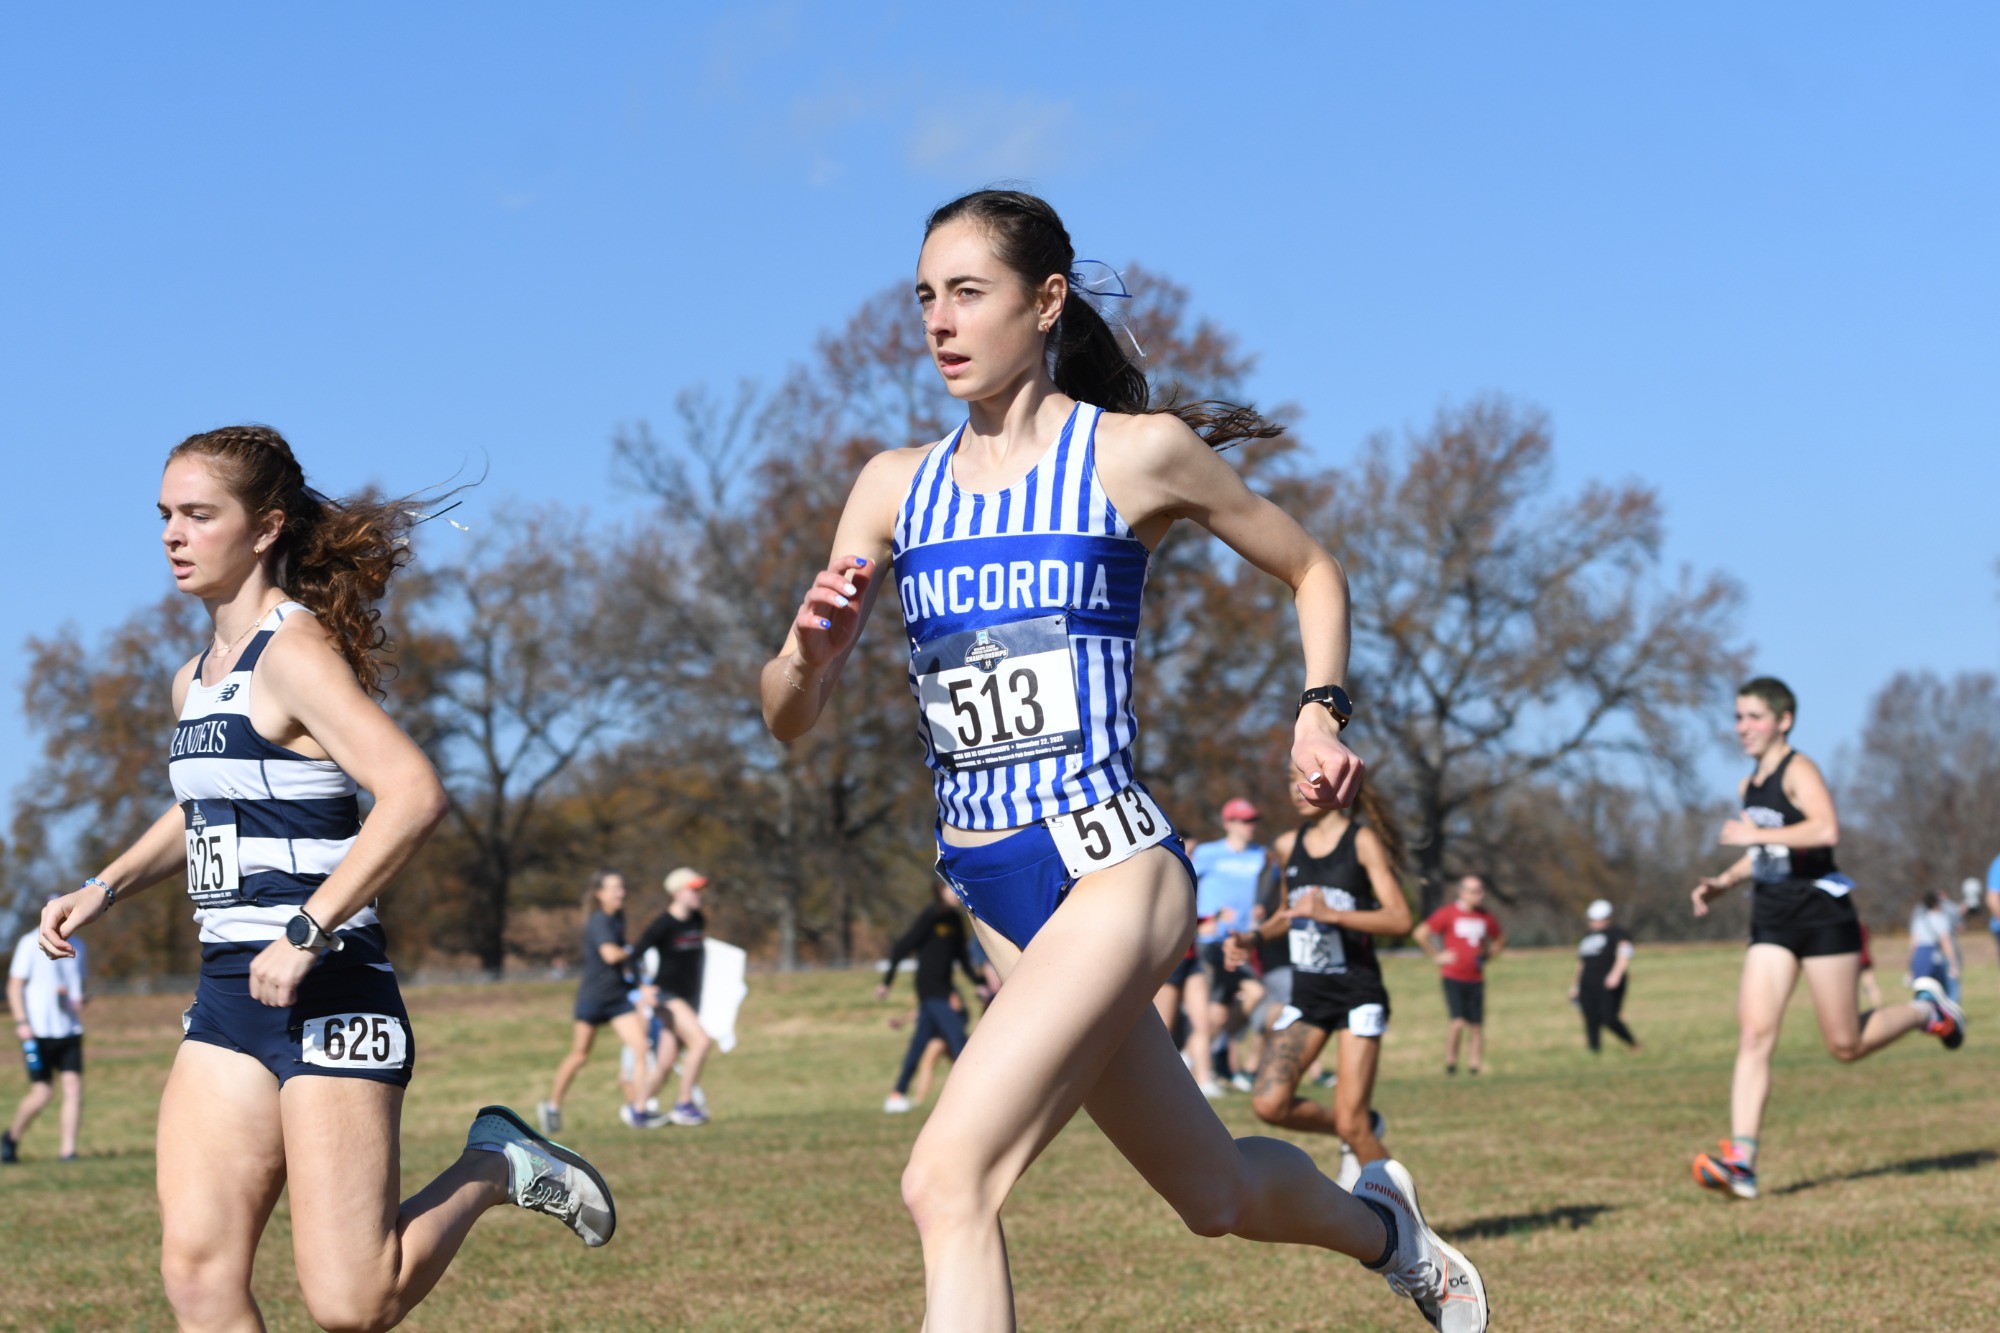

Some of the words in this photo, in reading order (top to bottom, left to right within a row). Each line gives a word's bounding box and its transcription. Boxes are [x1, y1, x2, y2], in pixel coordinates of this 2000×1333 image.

[901, 559, 1110, 624] ONCORDIA
[948, 668, 1044, 747] 513
[170, 720, 228, 757] RANDEIS
[1072, 785, 1156, 861] 513
[189, 836, 224, 892] 625
[324, 1016, 390, 1062] 625
